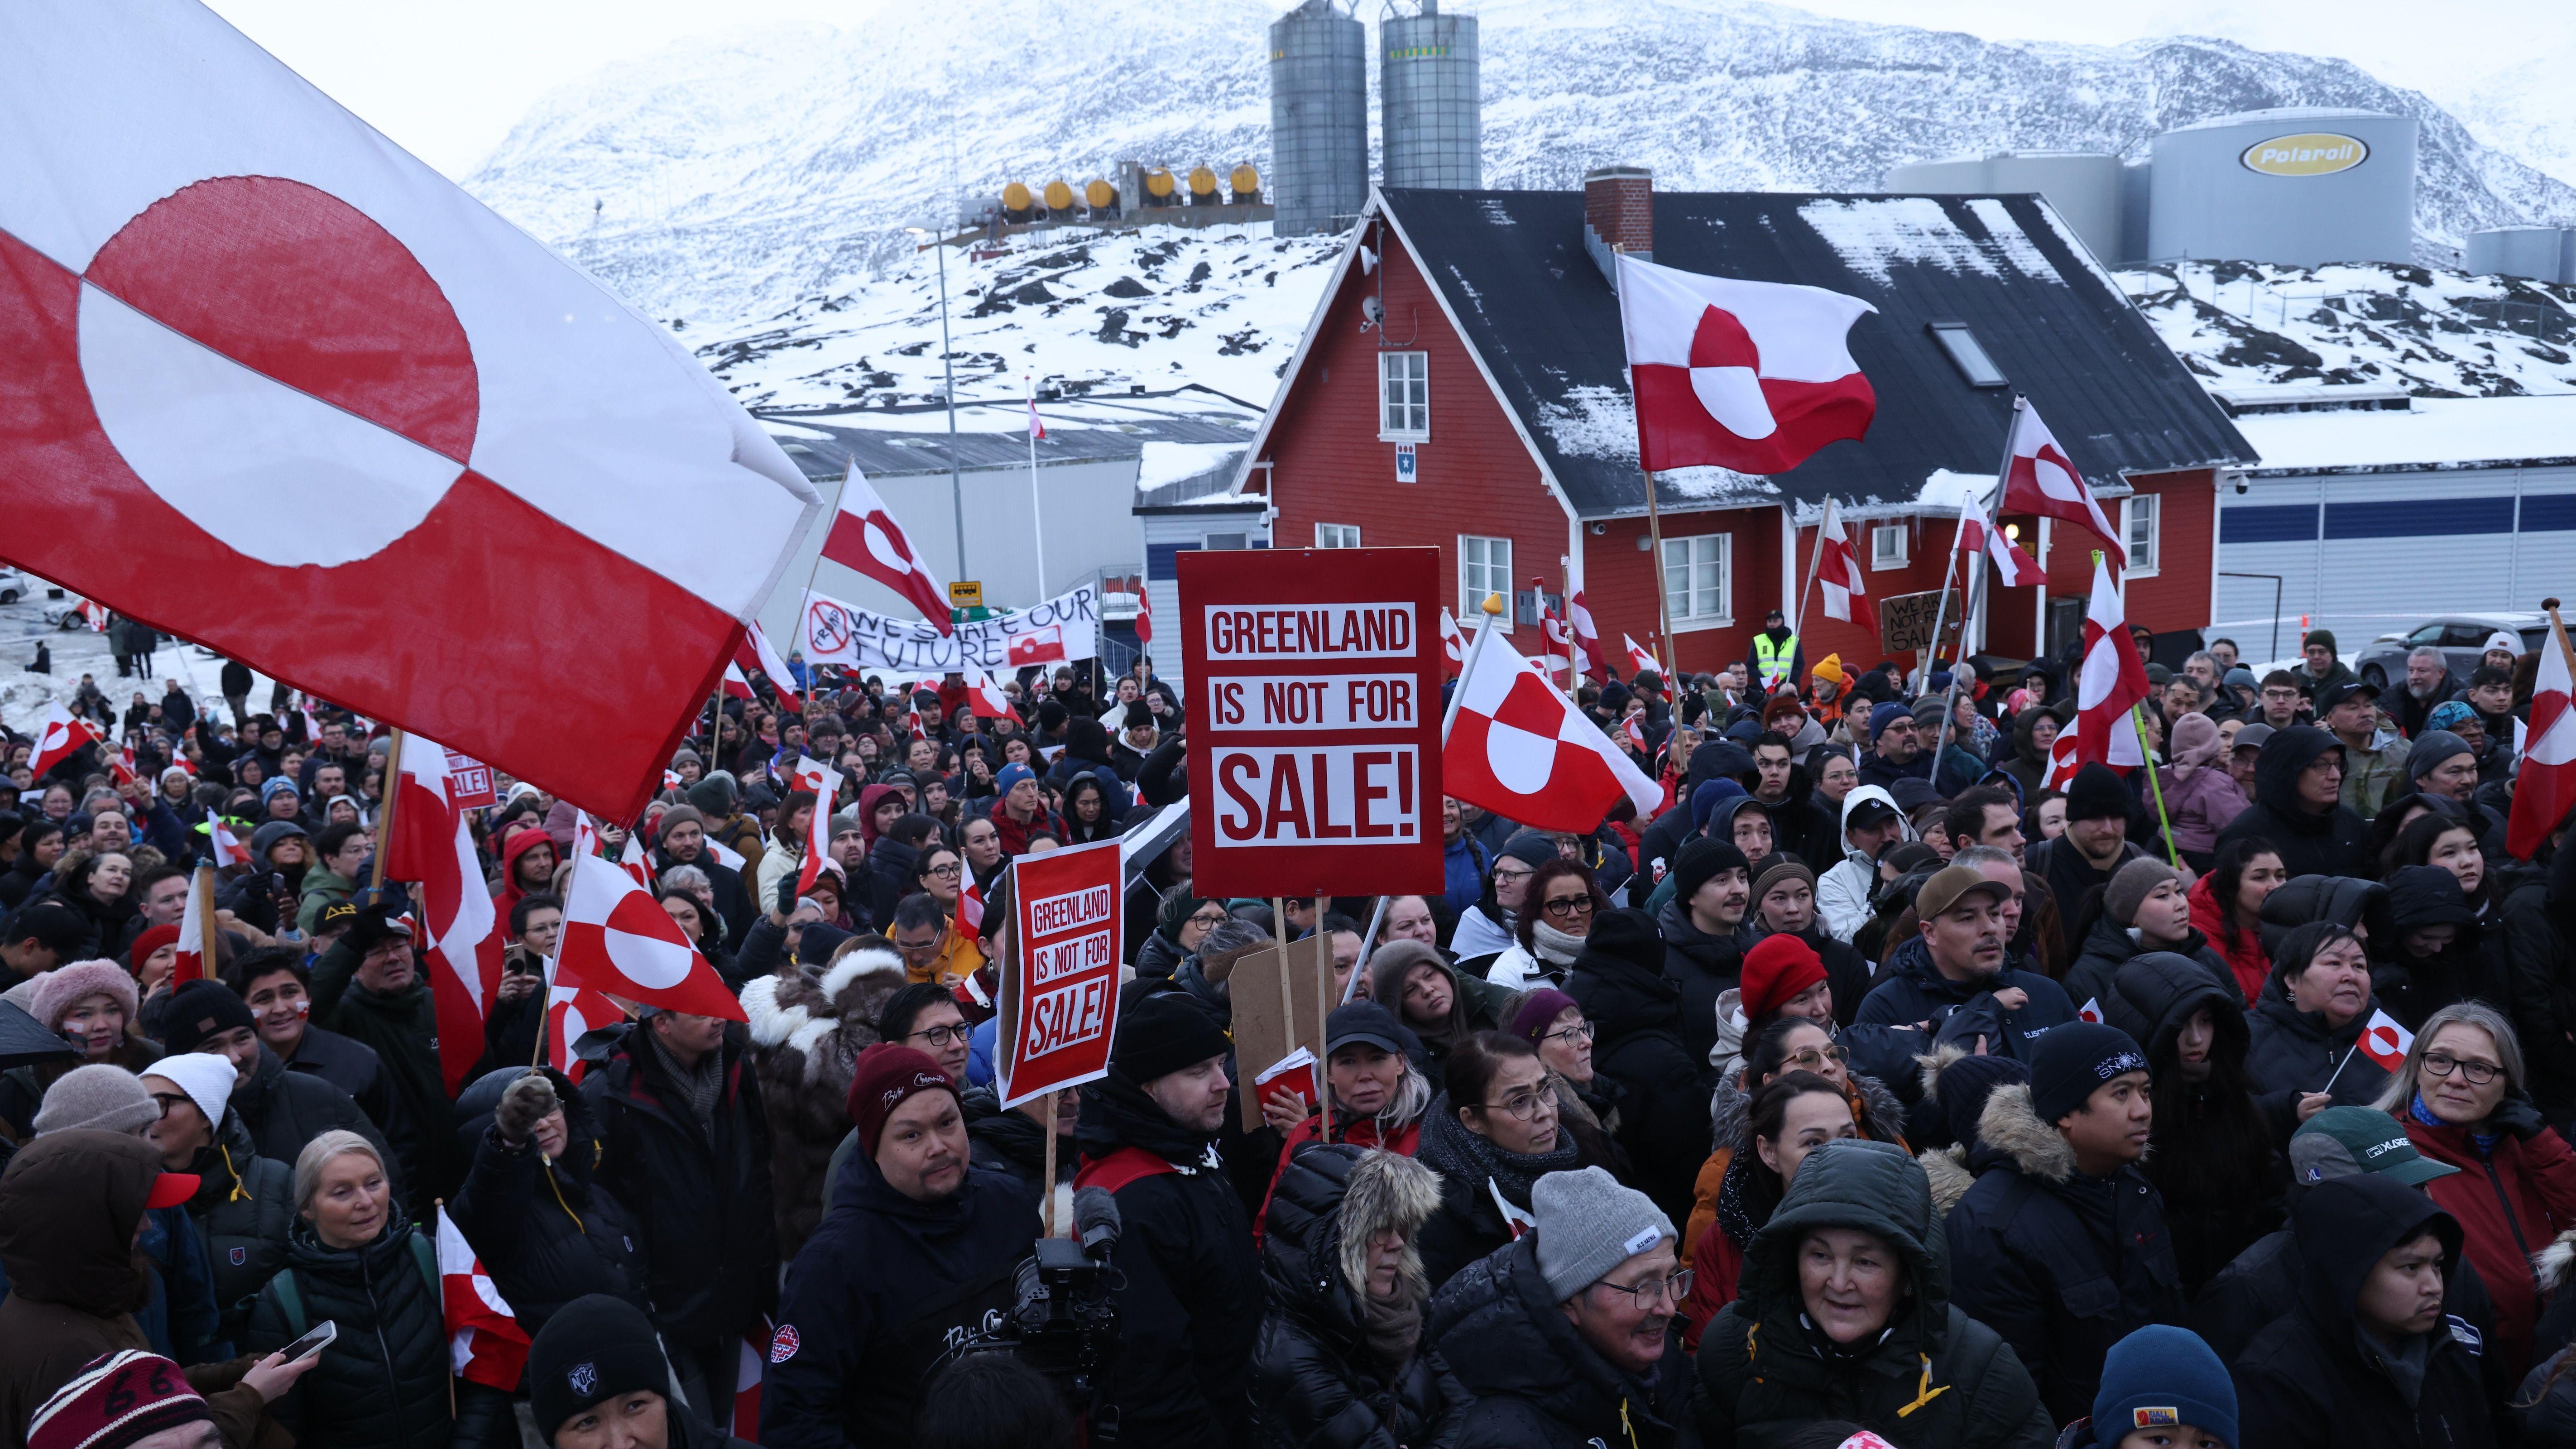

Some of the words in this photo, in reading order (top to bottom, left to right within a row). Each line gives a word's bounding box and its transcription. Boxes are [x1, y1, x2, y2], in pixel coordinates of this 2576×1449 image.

[2260, 144, 2354, 164] Polaroil
[845, 608, 901, 638] WE
[1029, 589, 1094, 627] OUR
[1889, 596, 1919, 615] WE
[813, 609, 839, 647] TRUMP
[1212, 609, 1410, 654] GREENLAND
[1890, 612, 1920, 631] NOT
[852, 631, 1003, 667] FUTURE
[1214, 682, 1245, 724] IS
[1263, 681, 1329, 724] NOT
[1348, 680, 1411, 722] FOR
[447, 757, 463, 768] NOT
[453, 770, 487, 794] ALE!
[1219, 751, 1414, 841] SALE!
[1034, 889, 1108, 933] GREENLAND
[1036, 950, 1048, 981] IS
[1055, 942, 1079, 975] NOT
[1085, 935, 1108, 966] FOR
[1029, 980, 1107, 1056] SALE!
[2093, 1056, 2114, 1072] NUUK
[2380, 1137, 2411, 1152] XLARGE
[2306, 1169, 2321, 1181] XL
[1636, 1241, 1645, 1250] BLS
[1643, 1234, 1657, 1245] HAFNIA
